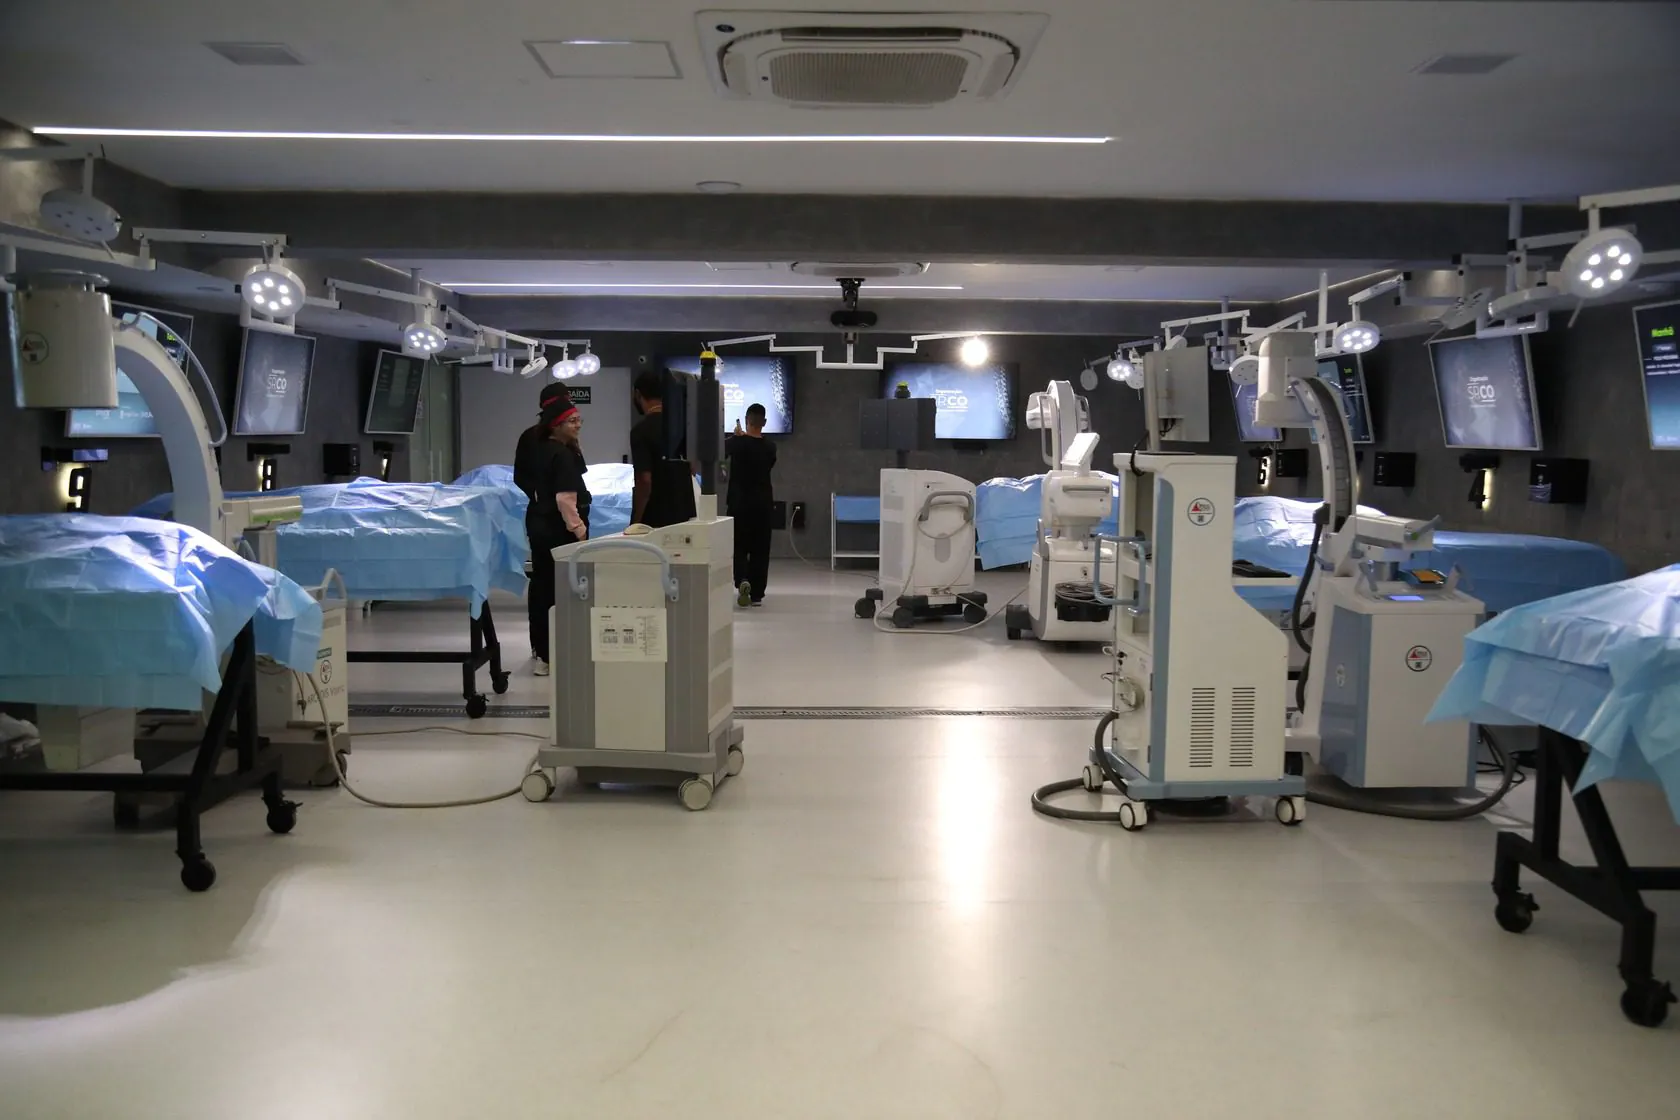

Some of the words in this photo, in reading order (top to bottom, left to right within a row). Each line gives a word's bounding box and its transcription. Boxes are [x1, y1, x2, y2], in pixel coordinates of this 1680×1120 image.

[267, 377, 287, 390] SRCO
[724, 389, 745, 400] CO
[1467, 384, 1495, 400] SRCO
[929, 395, 968, 406] RCO
[262, 458, 277, 492] 8
[1257, 457, 1268, 485] 6
[67, 468, 92, 513] 9
[1468, 470, 1487, 510] 4
